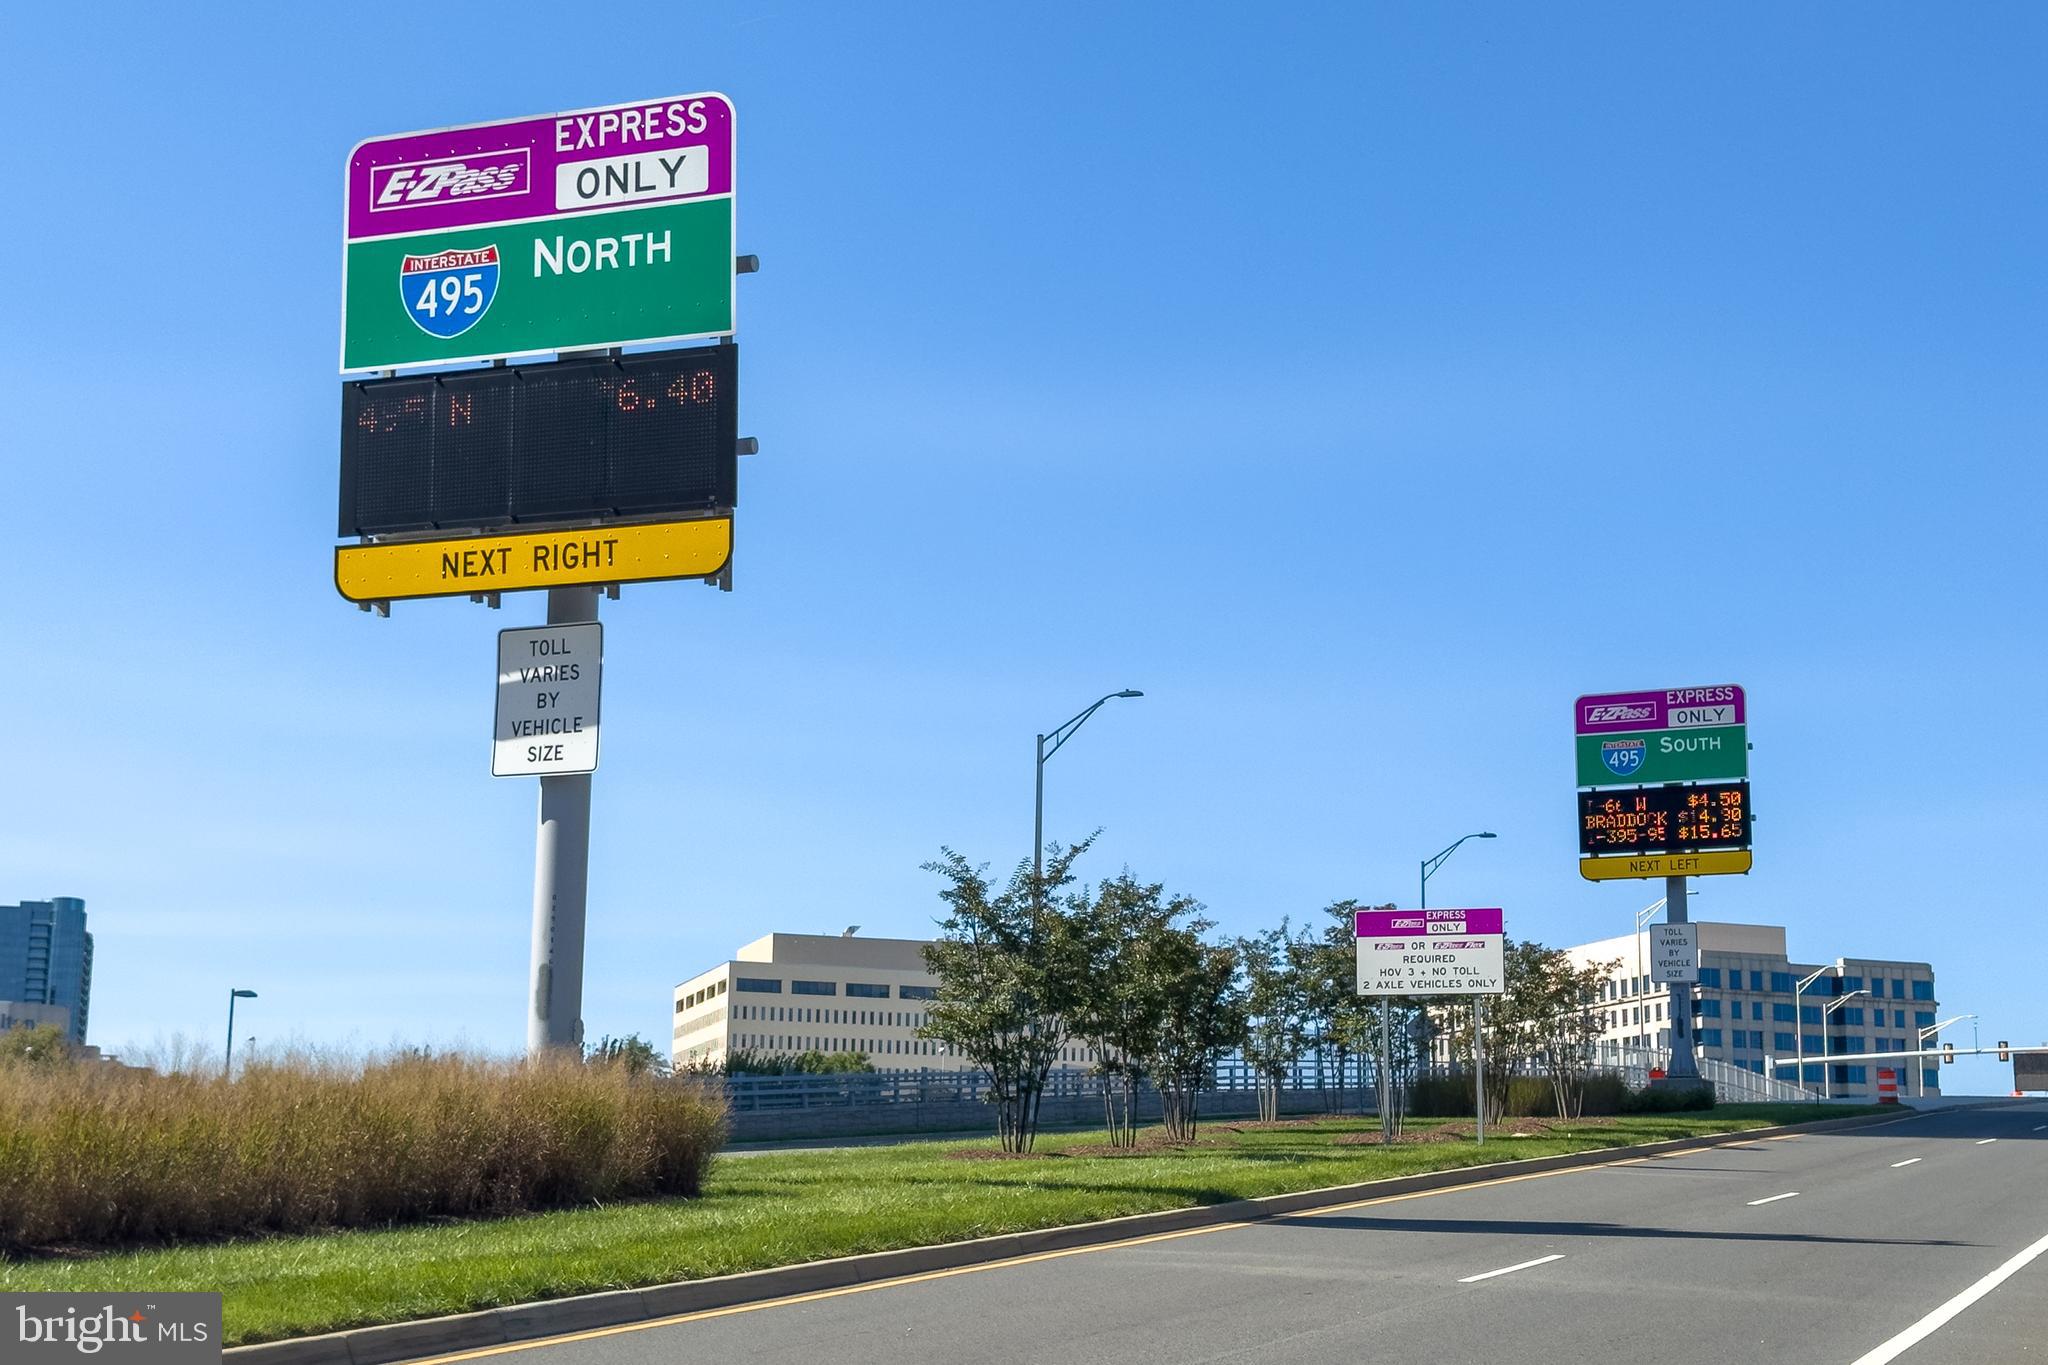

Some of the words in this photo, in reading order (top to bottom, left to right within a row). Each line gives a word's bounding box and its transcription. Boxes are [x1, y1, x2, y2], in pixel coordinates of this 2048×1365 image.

[555, 100, 708, 152] EXPRESS
[377, 163, 520, 205] E-ZPass
[576, 155, 687, 199] ONLY
[409, 251, 490, 273] INTERSTATE
[416, 273, 484, 318] 495
[451, 394, 472, 427] N
[442, 547, 511, 579] NEXT
[534, 539, 618, 573] RIGHT
[530, 638, 571, 656] TOLL
[520, 664, 580, 683] VARIES
[537, 692, 560, 709] BY
[1666, 687, 1734, 704] EXPRESS
[1677, 708, 1725, 724] ONLY
[512, 717, 583, 737] VEHICLE
[527, 744, 564, 762] SIZE
[1609, 750, 1639, 767] 495
[1687, 792, 1741, 808] $4.50
[1678, 823, 1742, 840] $15.65
[1630, 860, 1660, 872] NEXT
[1670, 858, 1699, 870] LEFT
[1426, 910, 1466, 919] EXPRESS
[1431, 923, 1461, 932] ONLY
[1664, 928, 1683, 936] TOLL
[1411, 942, 1426, 950] OR
[1660, 938, 1688, 946] VARIES
[1403, 954, 1456, 964] REQUIRED
[1669, 949, 1680, 957] BY
[1380, 968, 1402, 977] HOV
[1408, 968, 1414, 976] 3
[1432, 967, 1446, 976] NO
[1453, 966, 1480, 975] TOLL
[1658, 959, 1691, 967] VEHICLE
[1666, 970, 1683, 978] SIZE
[1363, 981, 1370, 990] 2
[1376, 980, 1403, 989] AXLE
[1410, 979, 1462, 989] VEHICLES
[1468, 979, 1497, 988] ONLY
